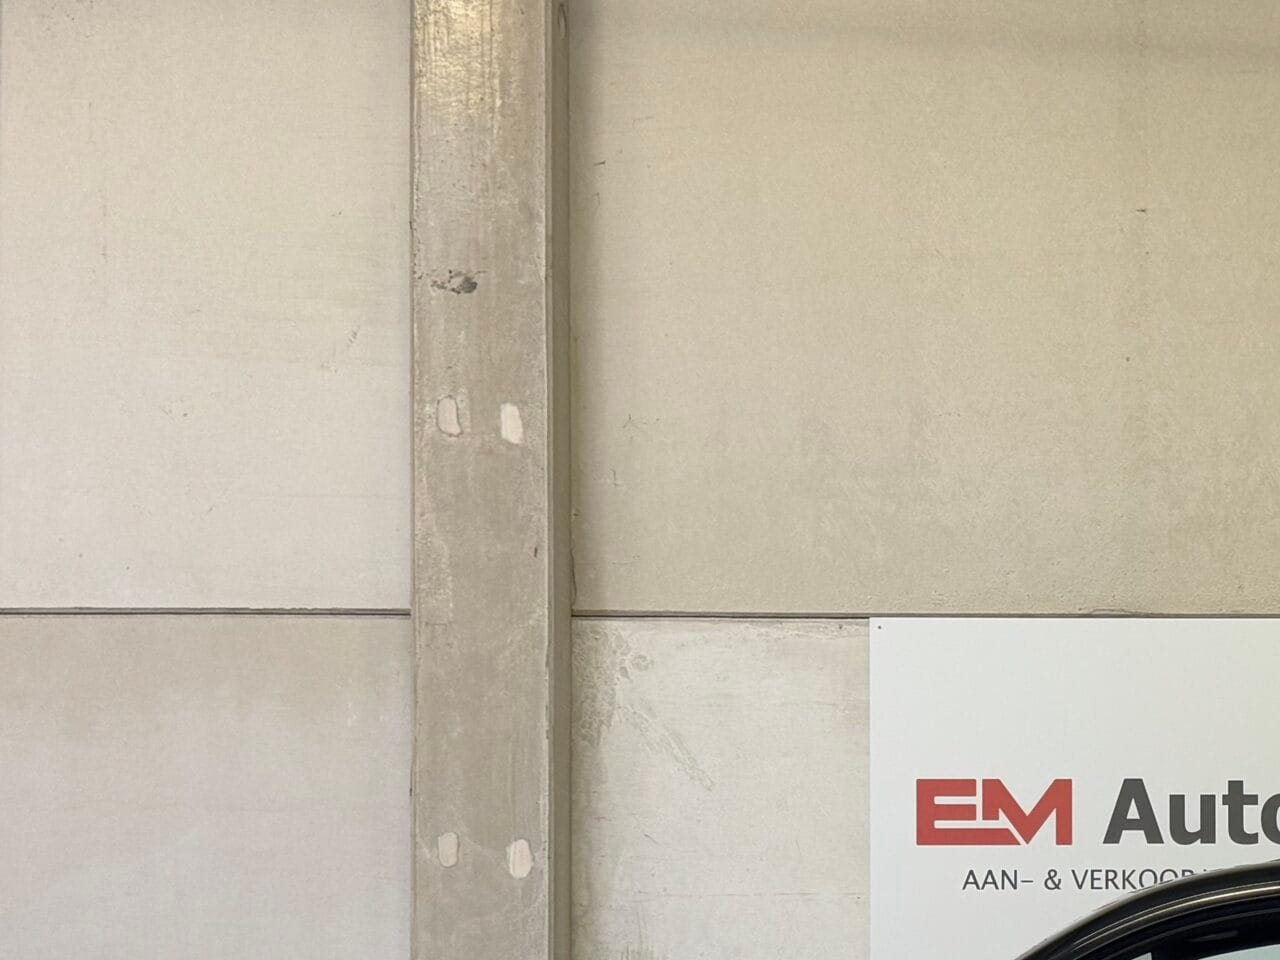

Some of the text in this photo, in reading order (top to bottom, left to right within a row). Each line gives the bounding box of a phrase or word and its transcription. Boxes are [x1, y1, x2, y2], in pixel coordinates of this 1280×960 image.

[916, 778, 1072, 845] EM
[962, 869, 1034, 890] AAN-
[1044, 869, 1062, 890] &
